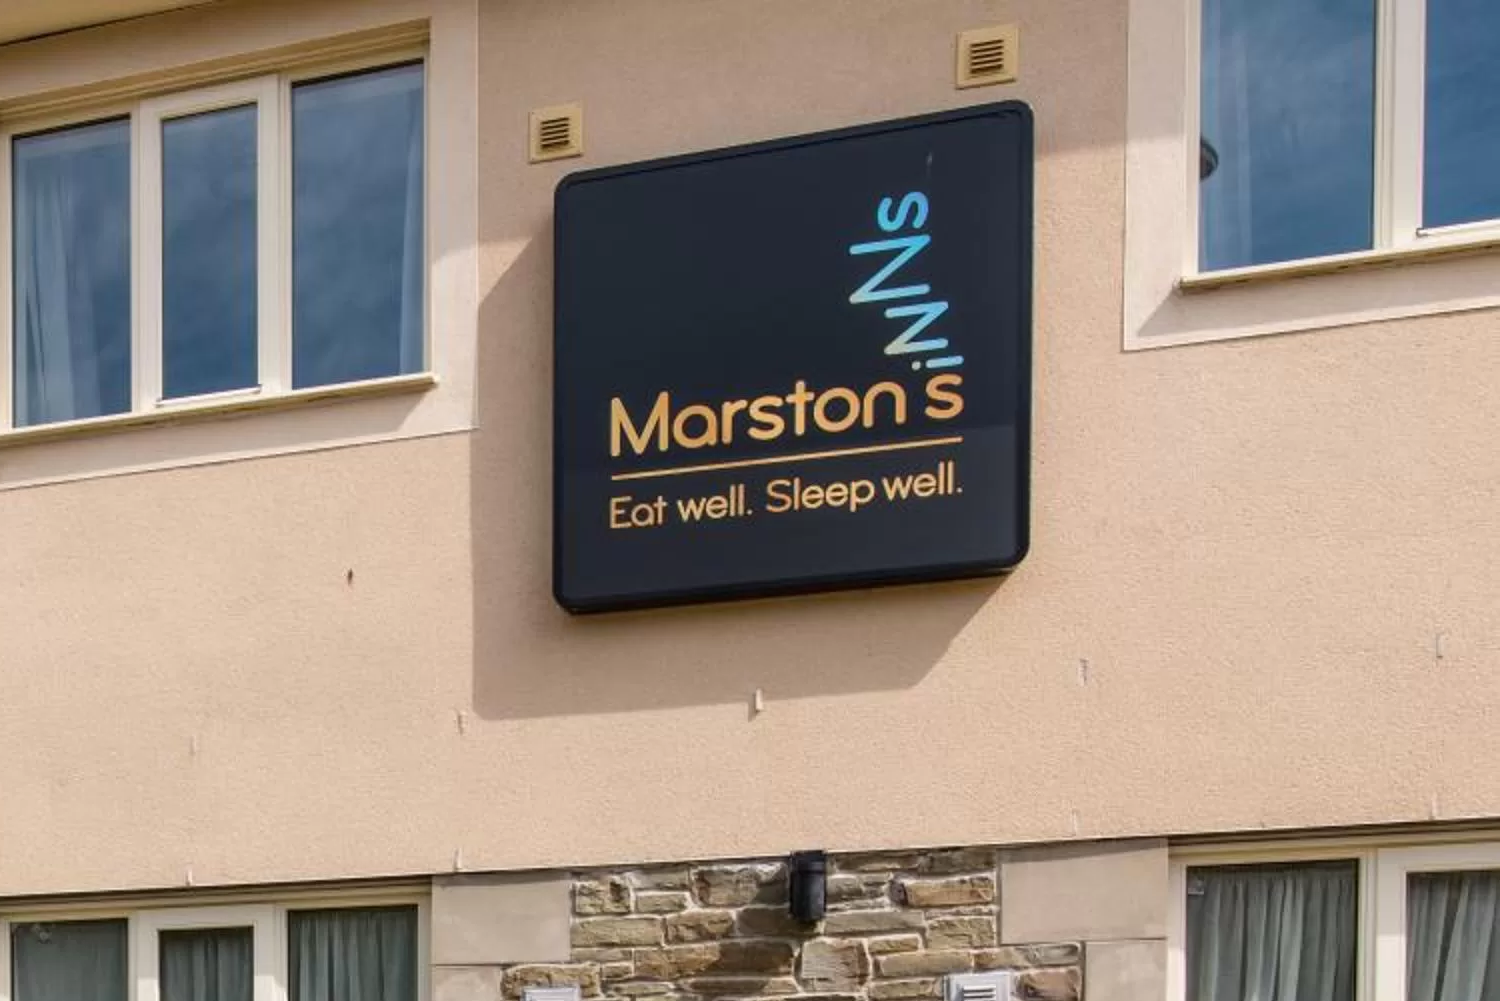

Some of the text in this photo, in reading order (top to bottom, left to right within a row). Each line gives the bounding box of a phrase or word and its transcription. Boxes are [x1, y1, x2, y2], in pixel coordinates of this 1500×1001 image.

[610, 460, 964, 529] Eat well. Sleep well.
